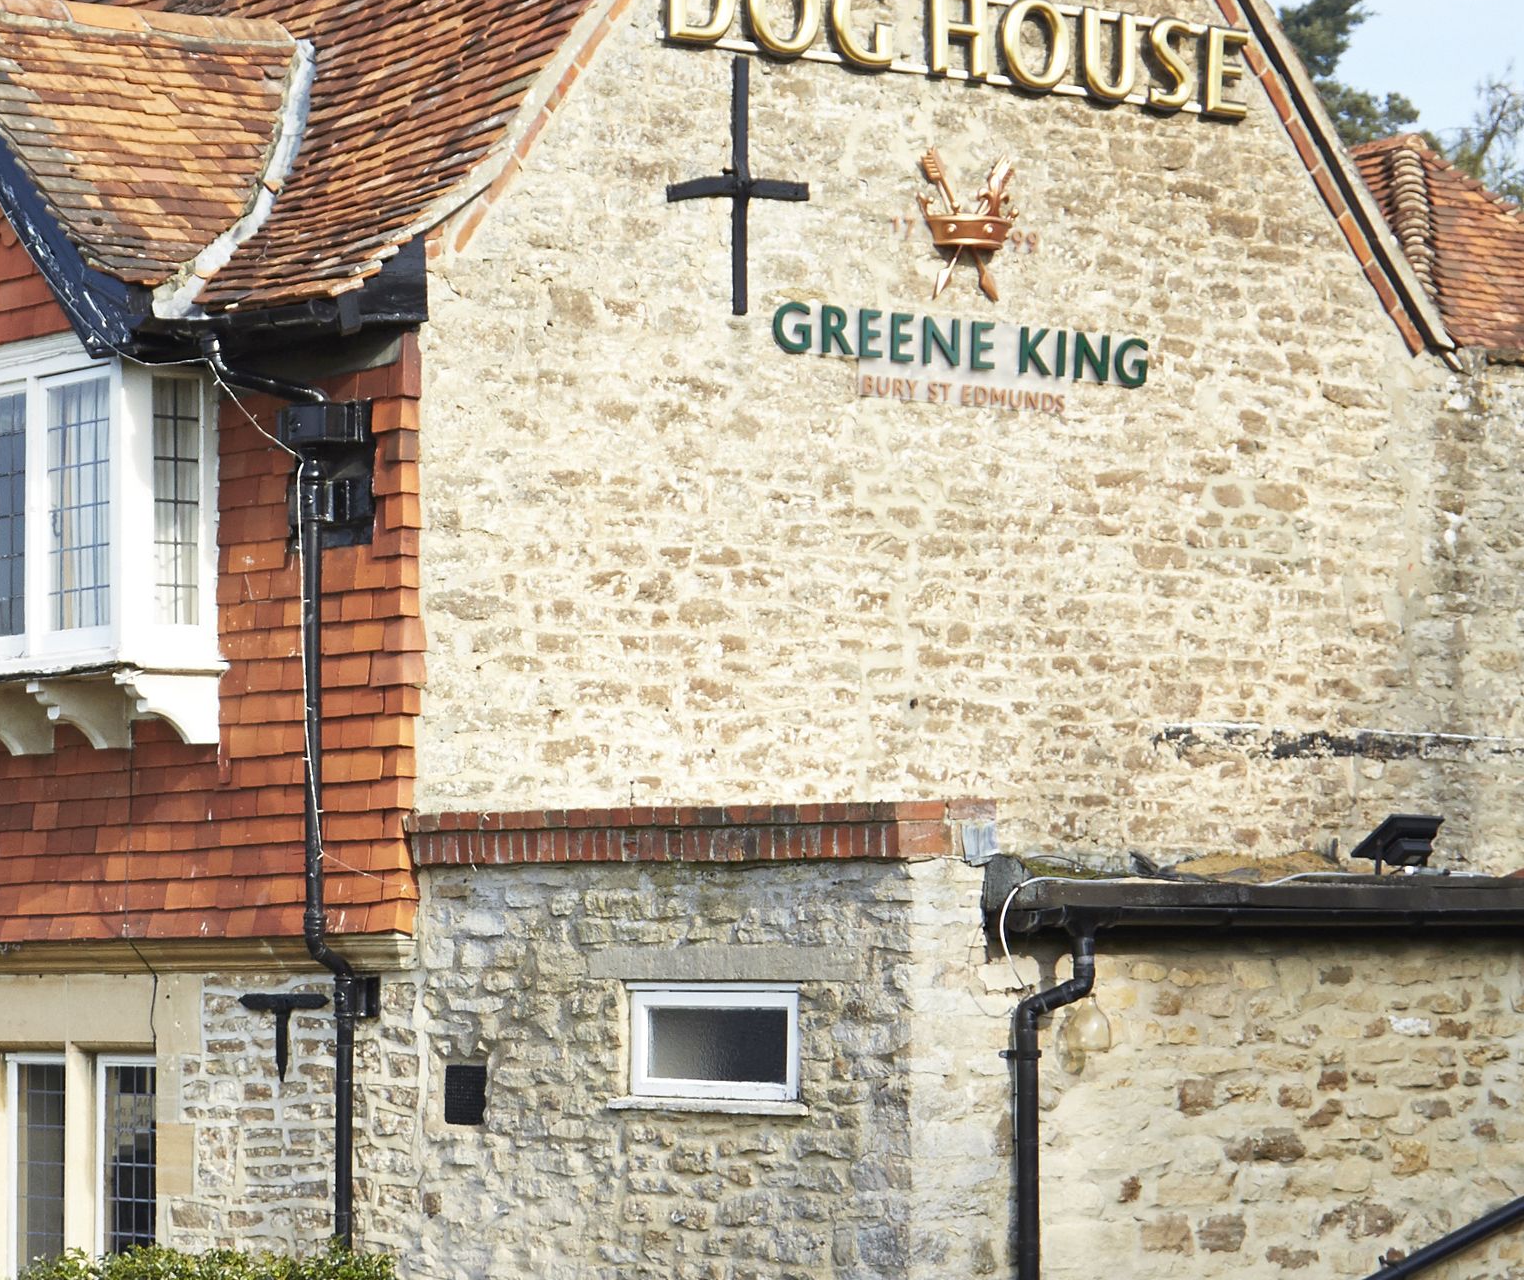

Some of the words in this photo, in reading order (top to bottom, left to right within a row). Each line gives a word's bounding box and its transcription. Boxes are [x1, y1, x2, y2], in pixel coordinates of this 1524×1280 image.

[772, 301, 996, 372] GREENE
[1018, 326, 1149, 389] KING
[861, 373, 917, 400] BURY
[927, 380, 951, 403] ST
[960, 383, 1066, 414] EDMUNDS
